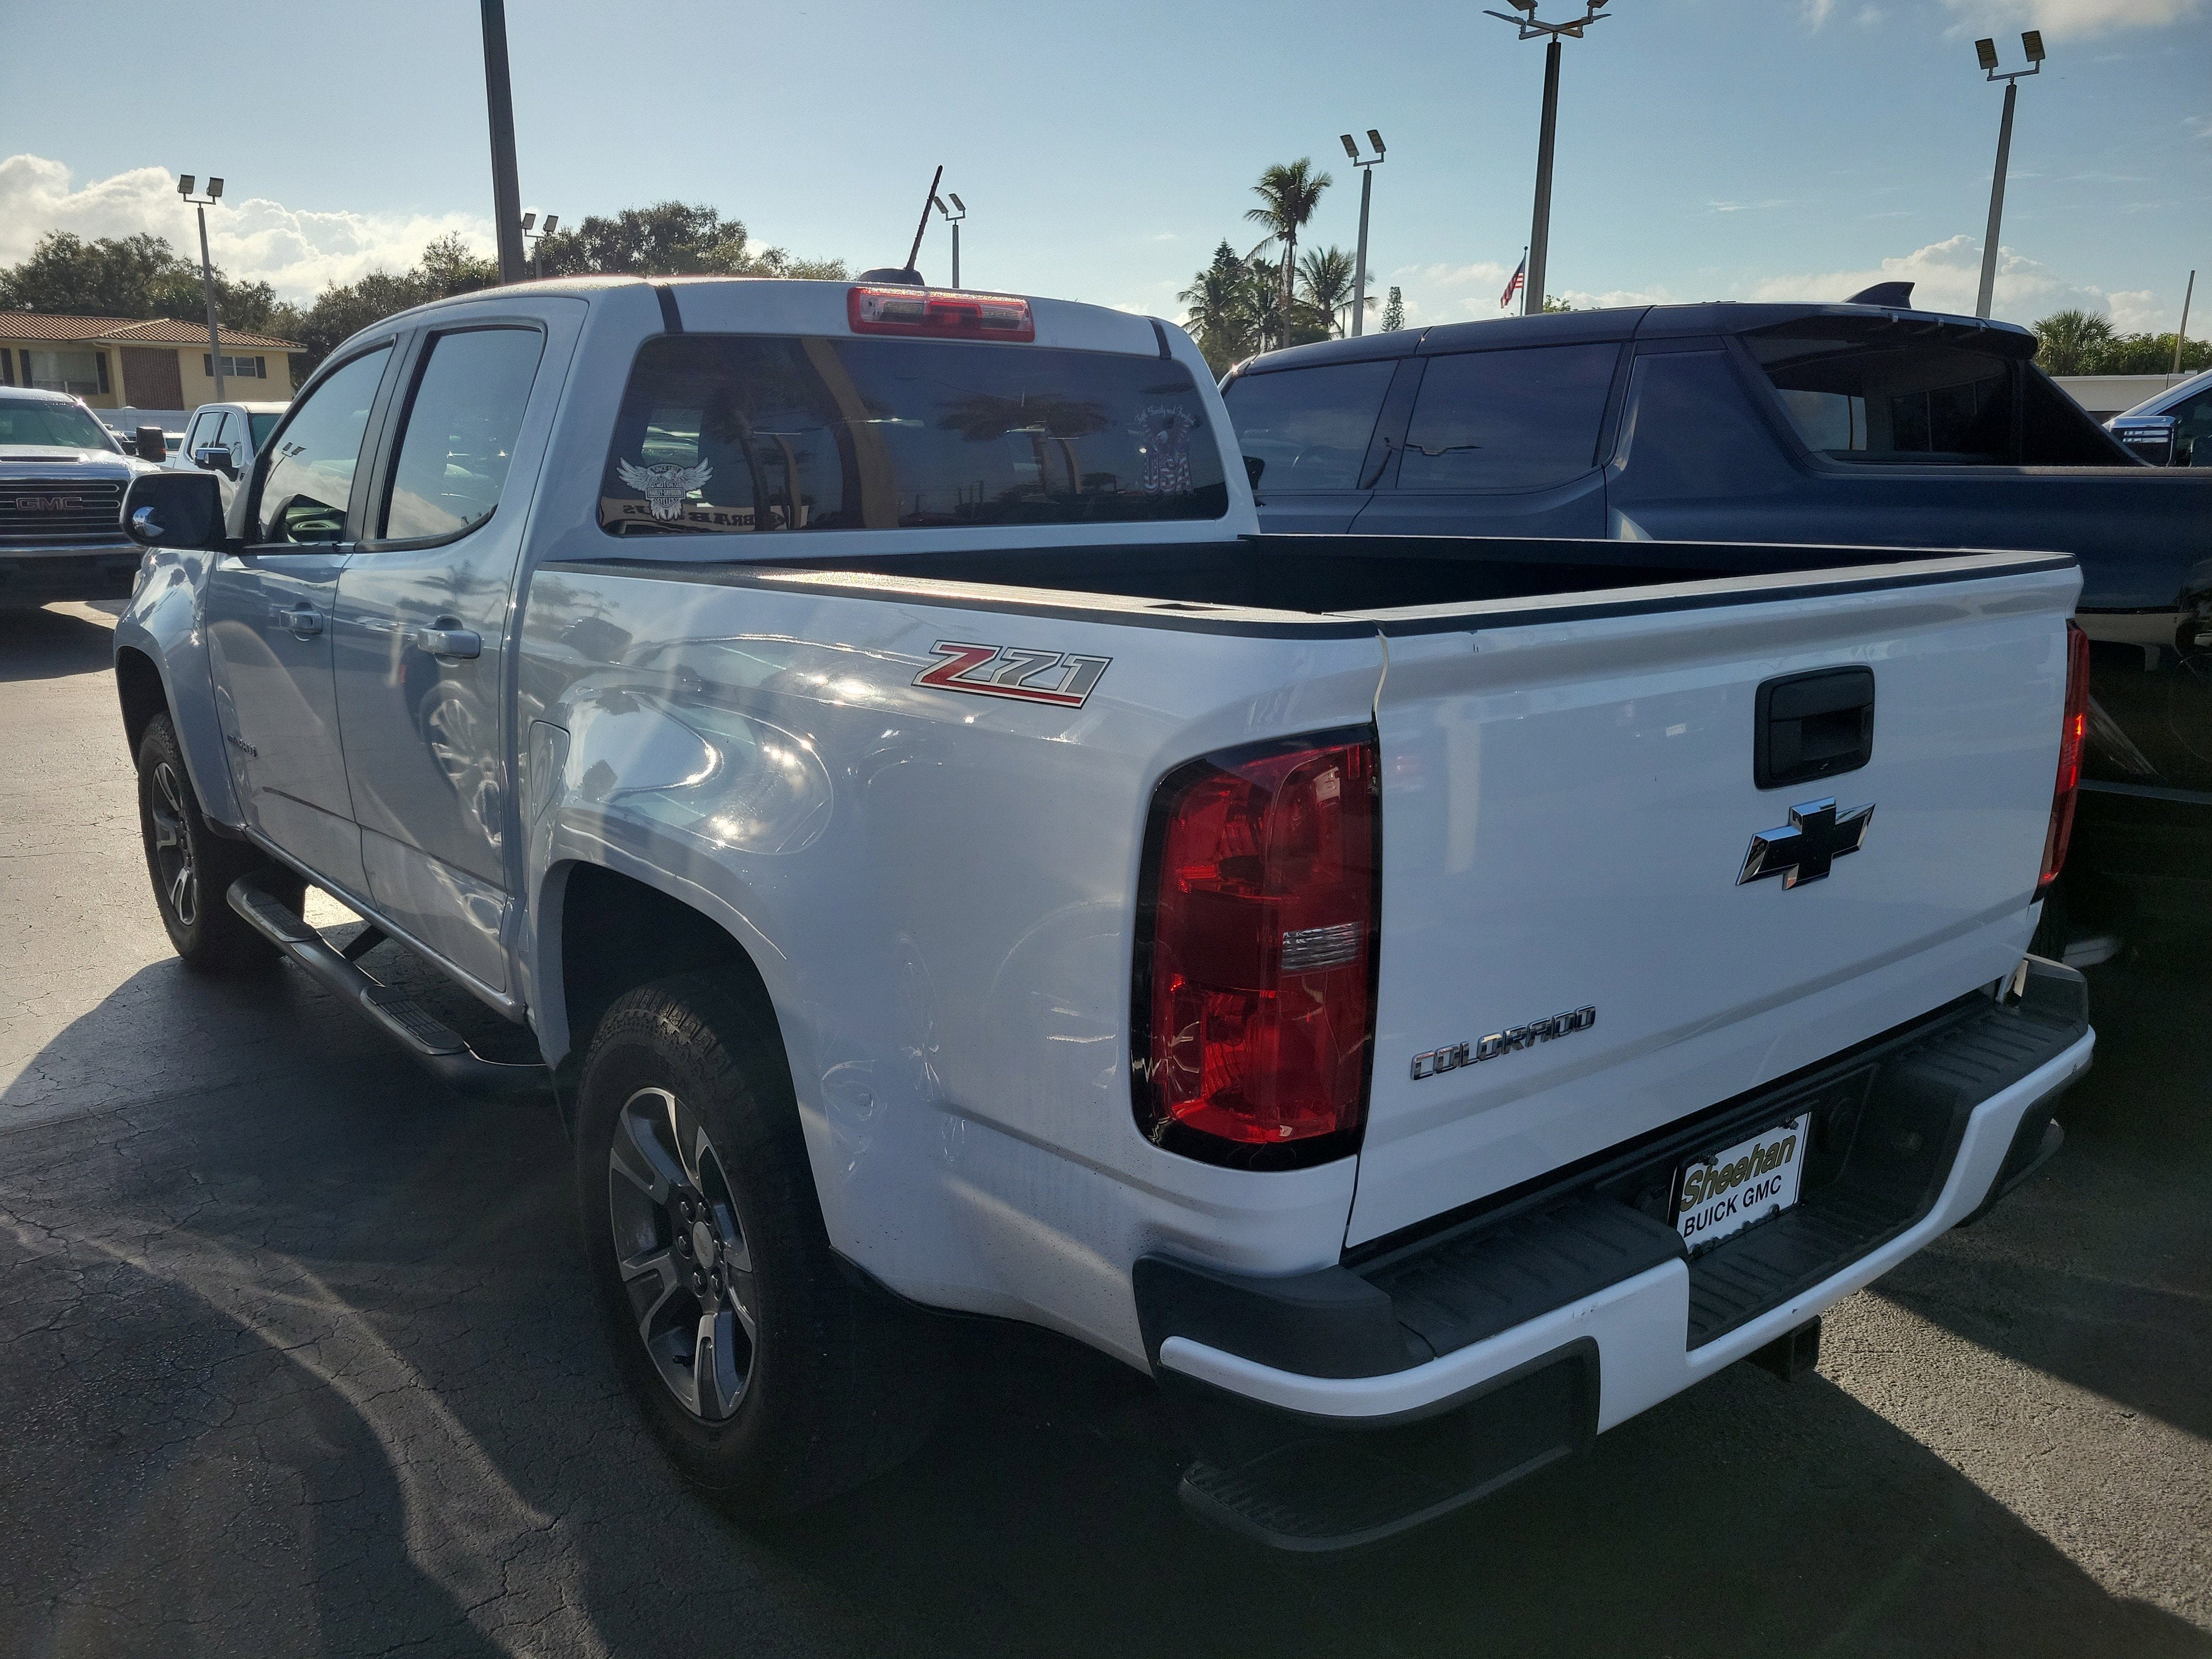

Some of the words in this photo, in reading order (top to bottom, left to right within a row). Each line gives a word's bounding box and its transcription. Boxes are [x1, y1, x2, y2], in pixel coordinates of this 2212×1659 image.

[16, 497, 83, 511] GMC
[1142, 453, 1193, 493] USA
[911, 640, 1113, 710] Z71
[1410, 1004, 1595, 1080] COLORADO
[1680, 1135, 1796, 1212] Sheehan
[1684, 1194, 1738, 1238] BUICK
[1743, 1175, 1781, 1207] GMC
